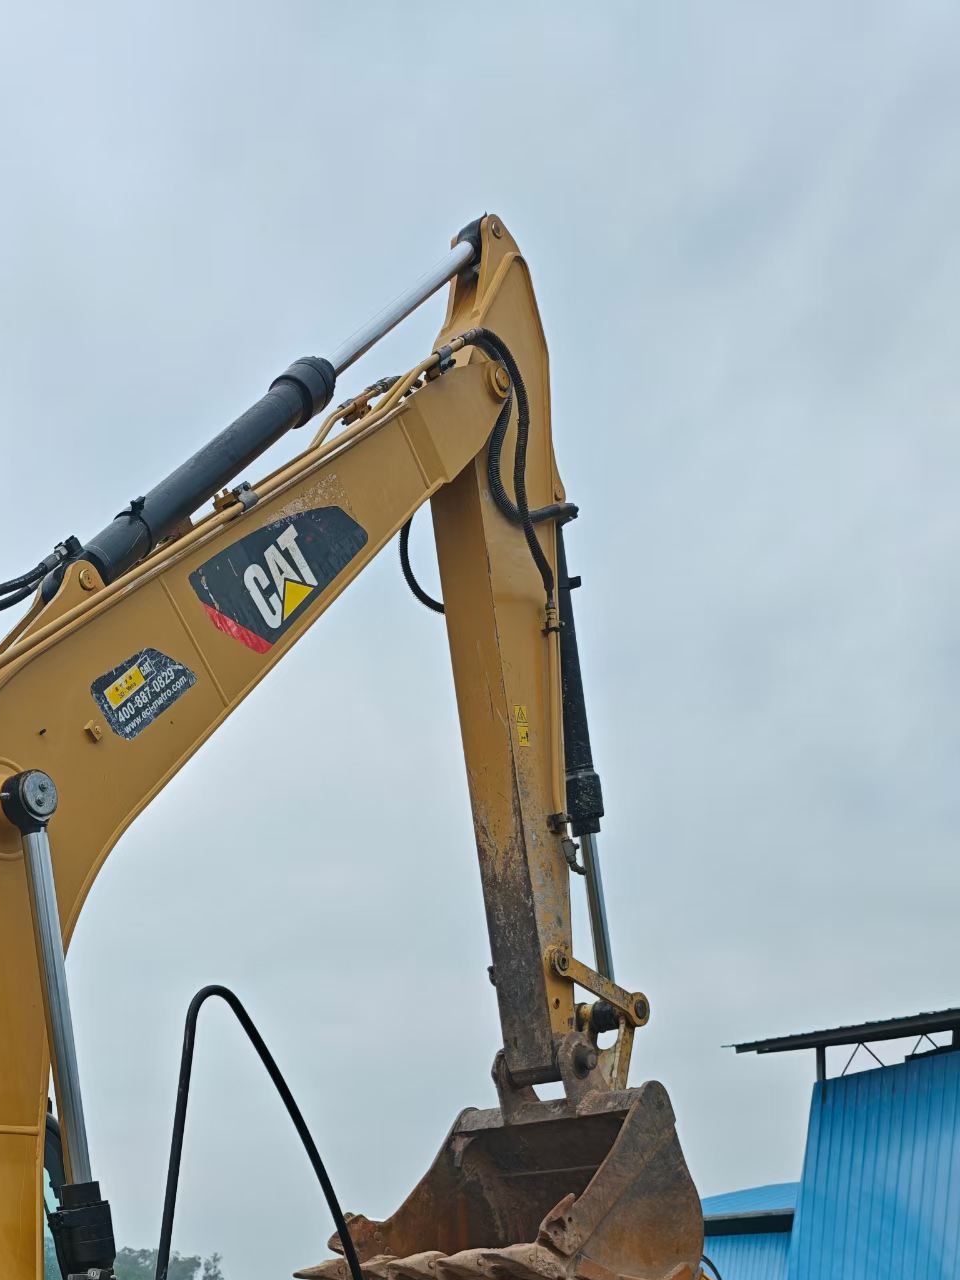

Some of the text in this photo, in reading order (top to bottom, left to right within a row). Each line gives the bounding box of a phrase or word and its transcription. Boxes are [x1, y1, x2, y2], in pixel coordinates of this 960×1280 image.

[243, 523, 319, 629] CAT
[118, 667, 175, 723] 400-887-0829
[140, 661, 154, 676] CAT
[124, 675, 187, 734] www.eci-metro.com
